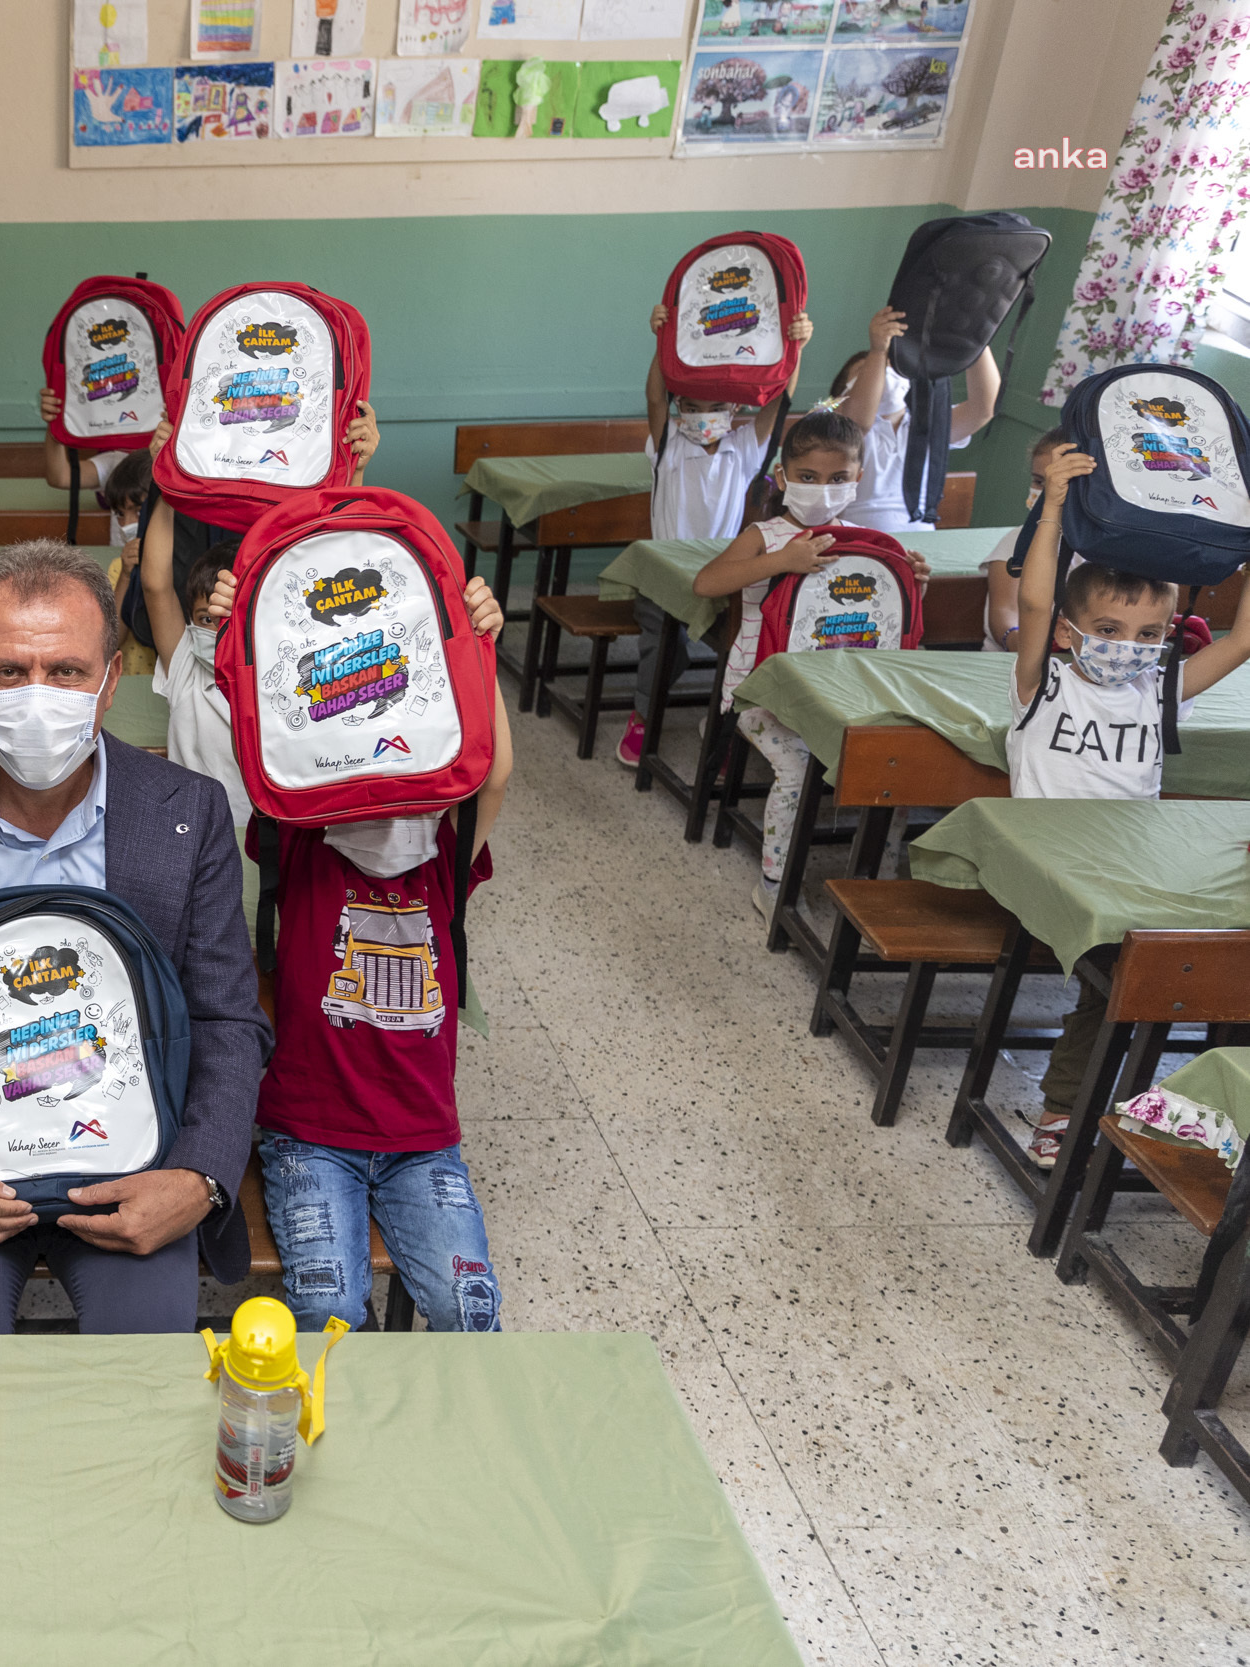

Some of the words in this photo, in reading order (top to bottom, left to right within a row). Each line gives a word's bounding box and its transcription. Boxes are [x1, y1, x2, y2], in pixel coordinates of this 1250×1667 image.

[697, 62, 758, 79] sonbahar
[243, 337, 292, 347] ÇANTAM
[258, 327, 276, 338] İLK
[232, 366, 289, 385] HEPİNİZE
[245, 380, 299, 396] DERSLER
[331, 578, 355, 595] İLK
[833, 586, 872, 596] ÇANTAM
[845, 578, 860, 586] İLK
[316, 586, 378, 613] ÇANTAM
[314, 629, 383, 667] HEPİNİZE
[311, 664, 332, 686] İYİ
[334, 643, 400, 679] DERSLER
[308, 692, 356, 721] VAHAP
[358, 673, 405, 700] SEÇER
[1049, 712, 1160, 763] EATI
[315, 757, 341, 771] Vahap
[29, 957, 53, 973] İLK
[13, 965, 75, 991] ÇANTAM
[10, 1009, 80, 1044] HEPİNİZE
[6, 1042, 27, 1063] İYİ
[29, 1024, 96, 1058] DERSLER
[3, 1071, 52, 1100] VAHAP
[54, 1054, 100, 1079] SEÇER
[8, 1139, 36, 1156] Vahap
[452, 1254, 487, 1280] Jeans
